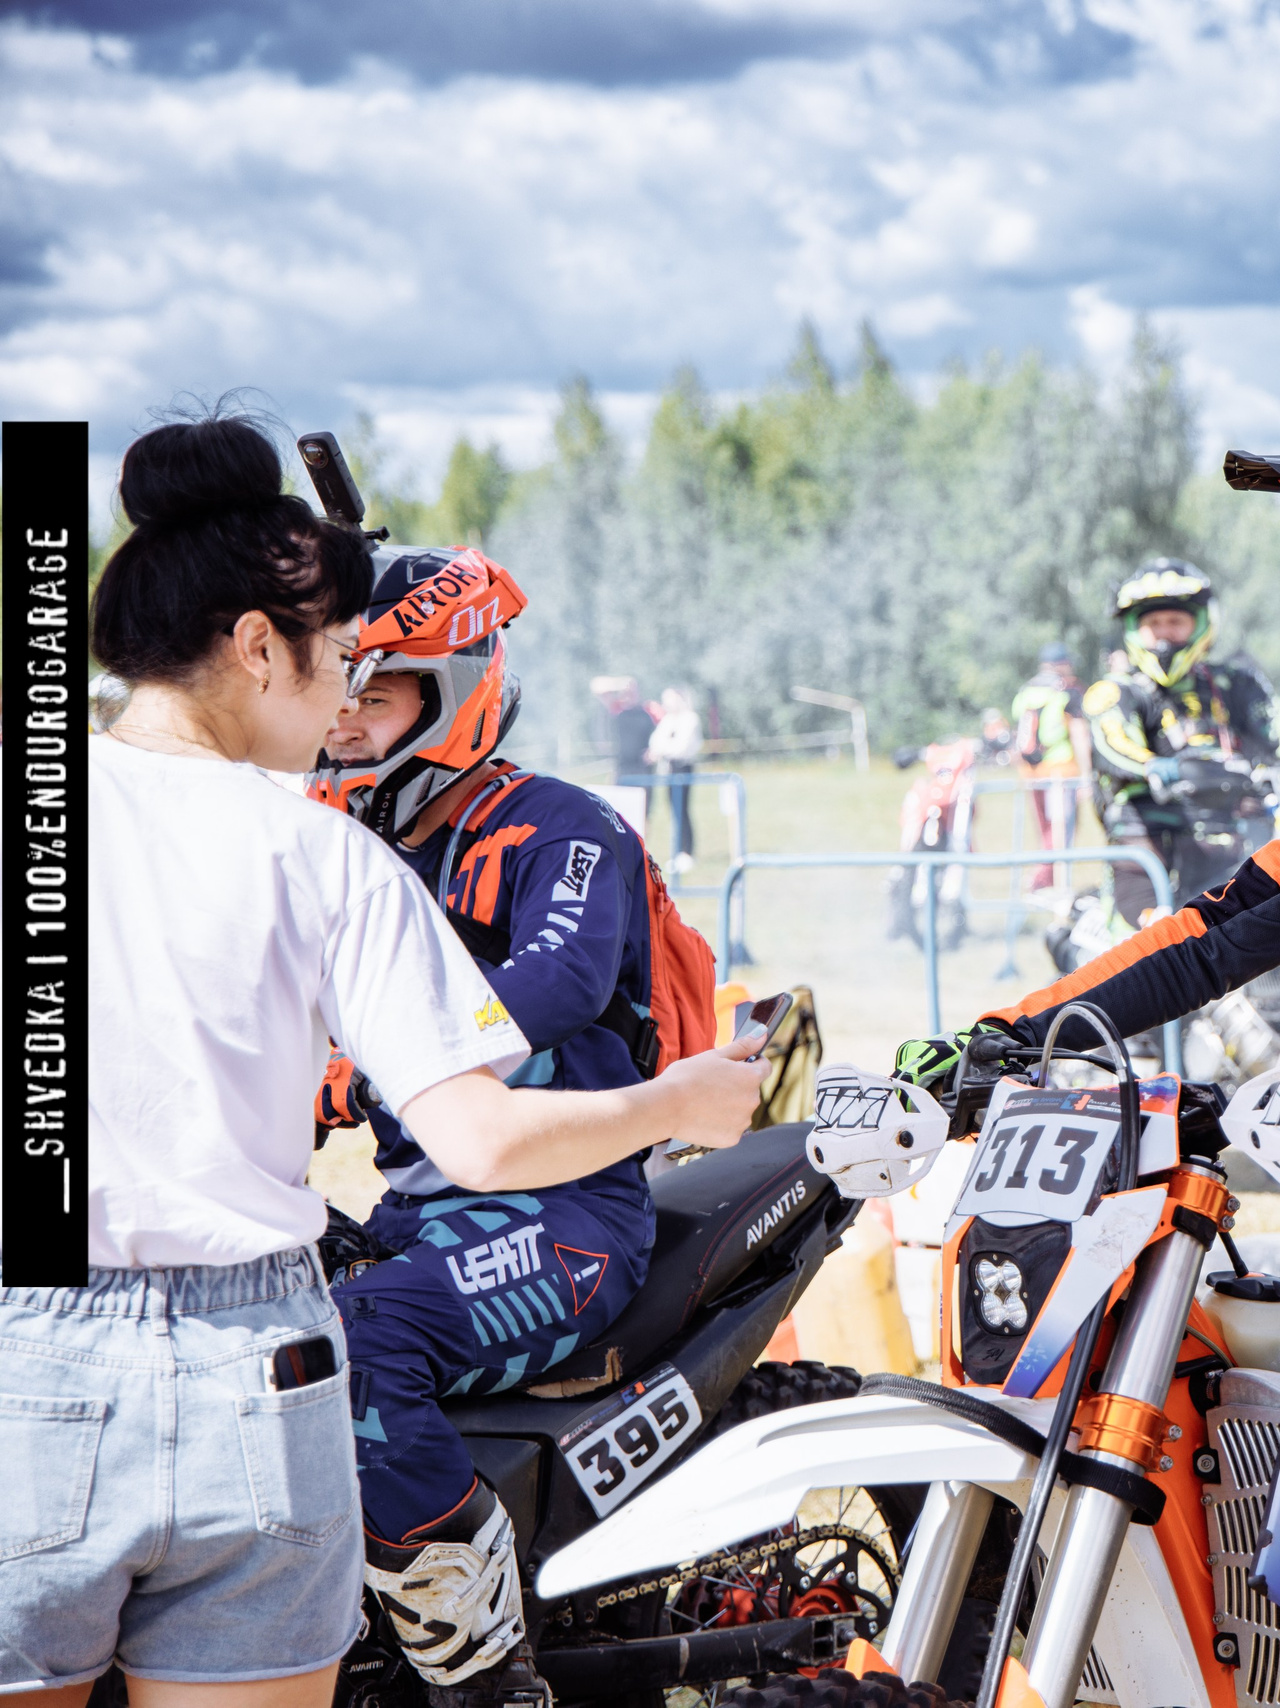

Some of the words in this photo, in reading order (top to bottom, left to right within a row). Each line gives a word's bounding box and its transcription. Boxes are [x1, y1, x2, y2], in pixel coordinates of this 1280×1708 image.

[376, 792, 392, 834] AIROH
[973, 1124, 1099, 1195] 313
[746, 1179, 807, 1251] AVANTIS
[445, 1222, 545, 1296] LEATT
[577, 1388, 690, 1497] 395
